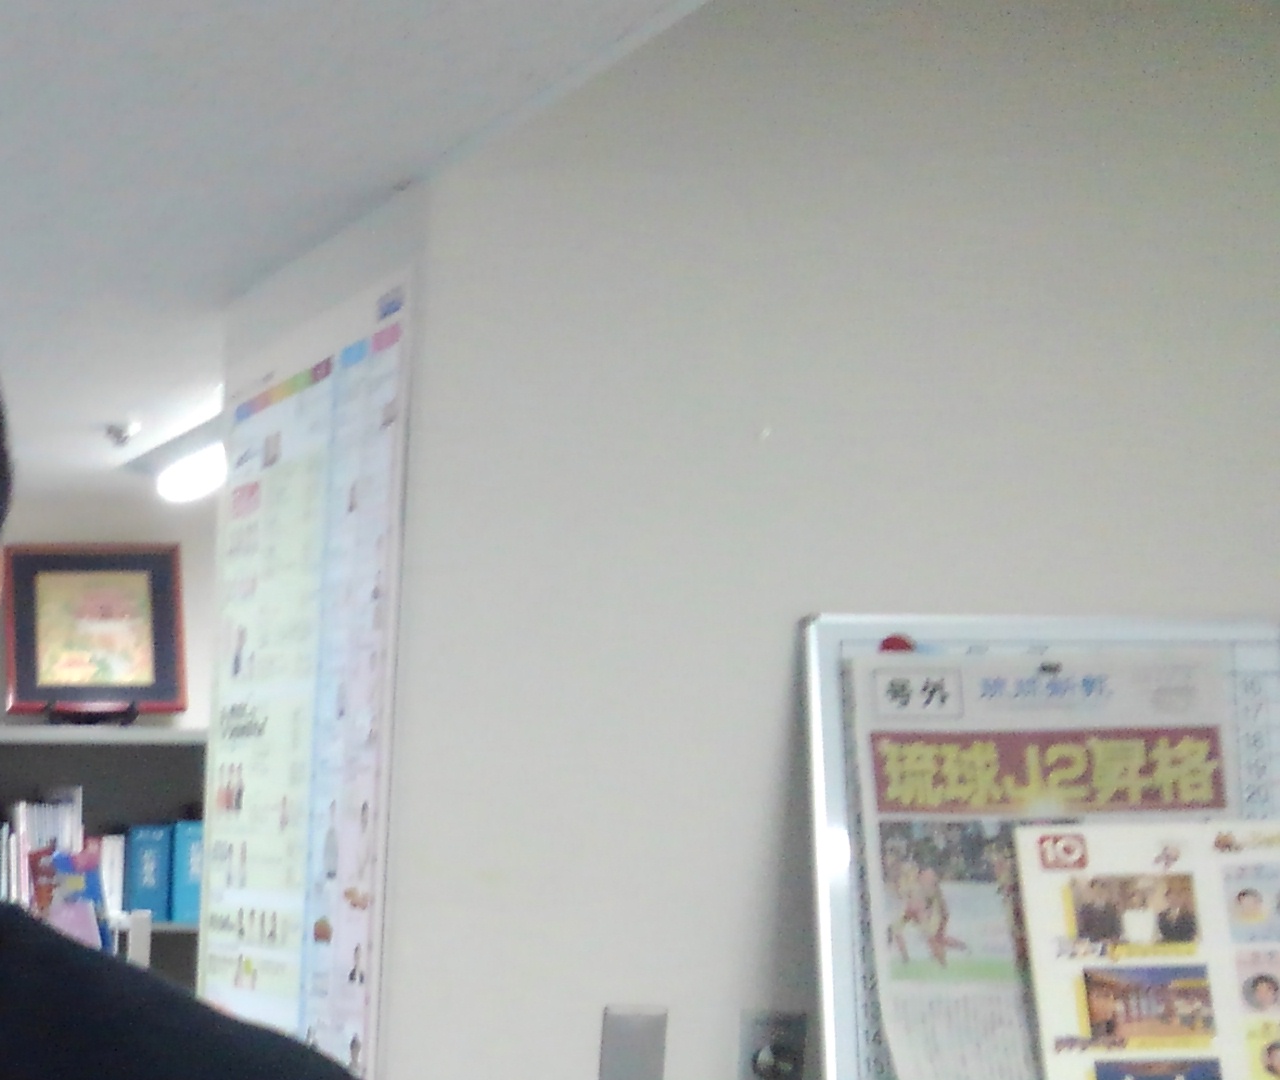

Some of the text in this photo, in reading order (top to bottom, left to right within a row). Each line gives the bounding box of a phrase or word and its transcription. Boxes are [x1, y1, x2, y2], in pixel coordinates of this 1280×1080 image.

[886, 677, 949, 708] 号外
[878, 735, 1218, 808] 琉球J2昇格
